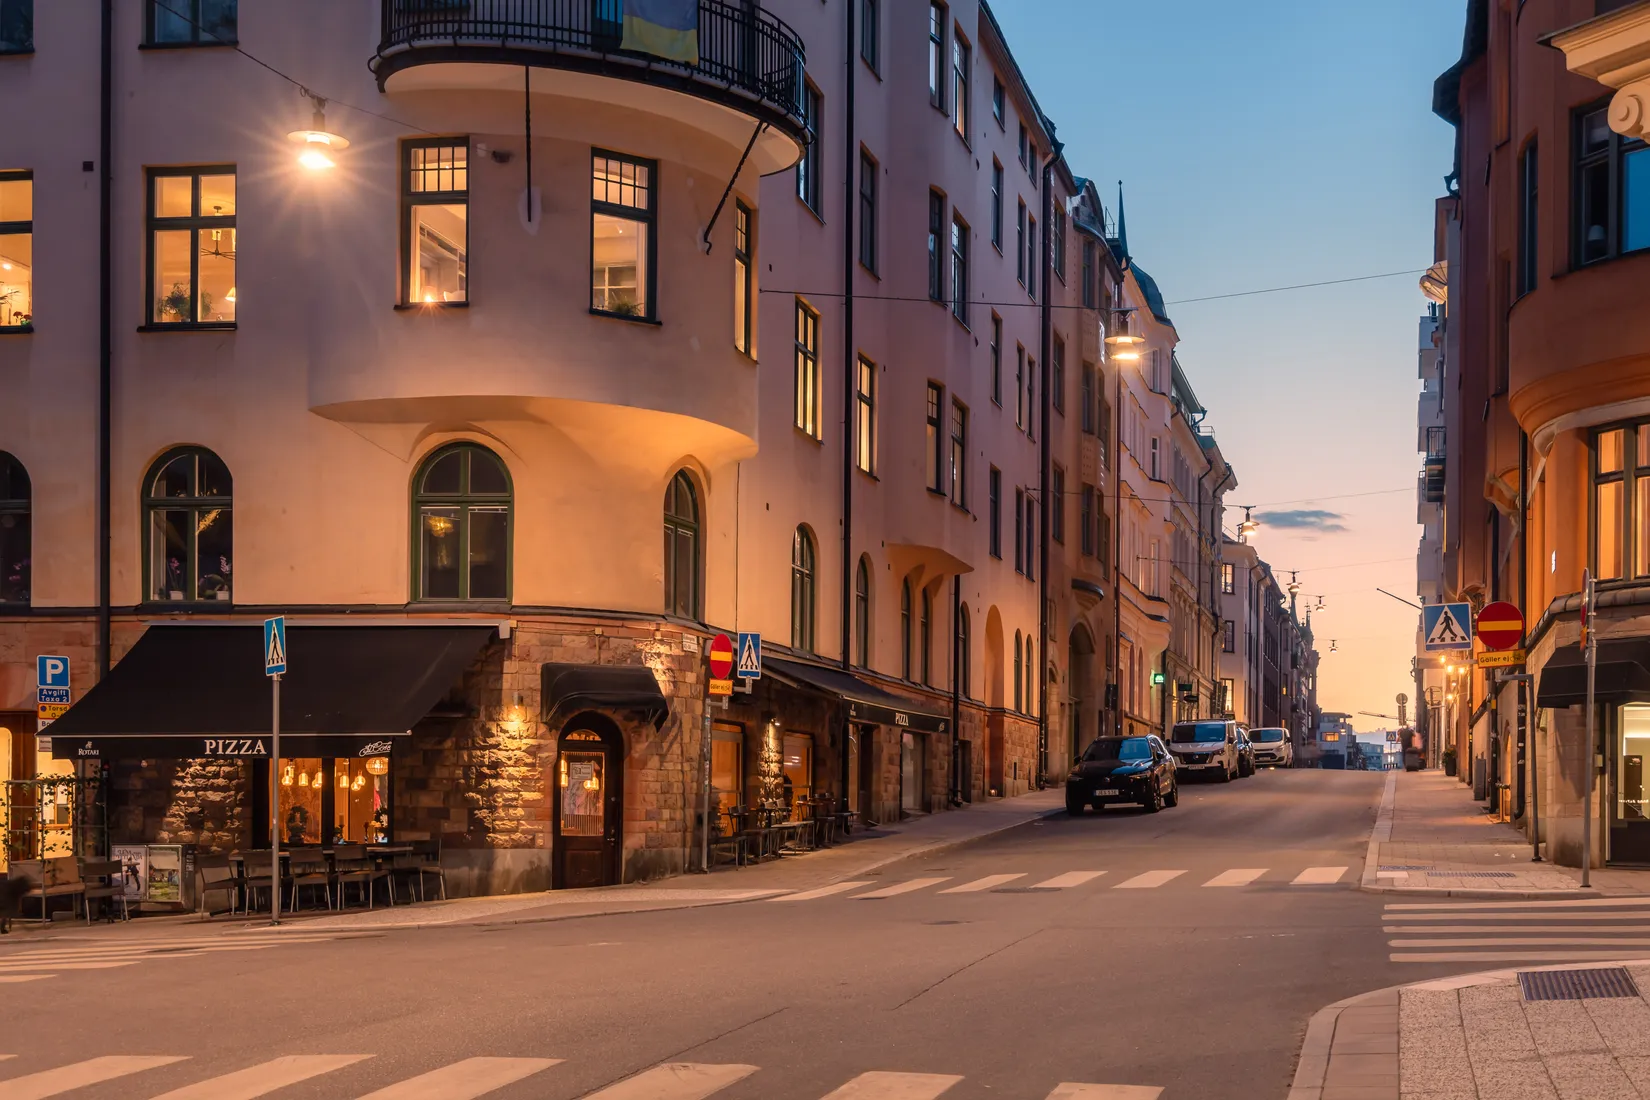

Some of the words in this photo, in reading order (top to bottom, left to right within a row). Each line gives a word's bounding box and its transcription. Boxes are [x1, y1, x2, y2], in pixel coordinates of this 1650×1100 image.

[1480, 656, 1501, 664] Gäller
[1502, 655, 1510, 663] ej
[46, 658, 64, 684] P
[42, 689, 66, 697] Avgift
[895, 712, 909, 726] PIZZA
[78, 748, 99, 756] ROTARI
[204, 739, 267, 755] PIZZA
